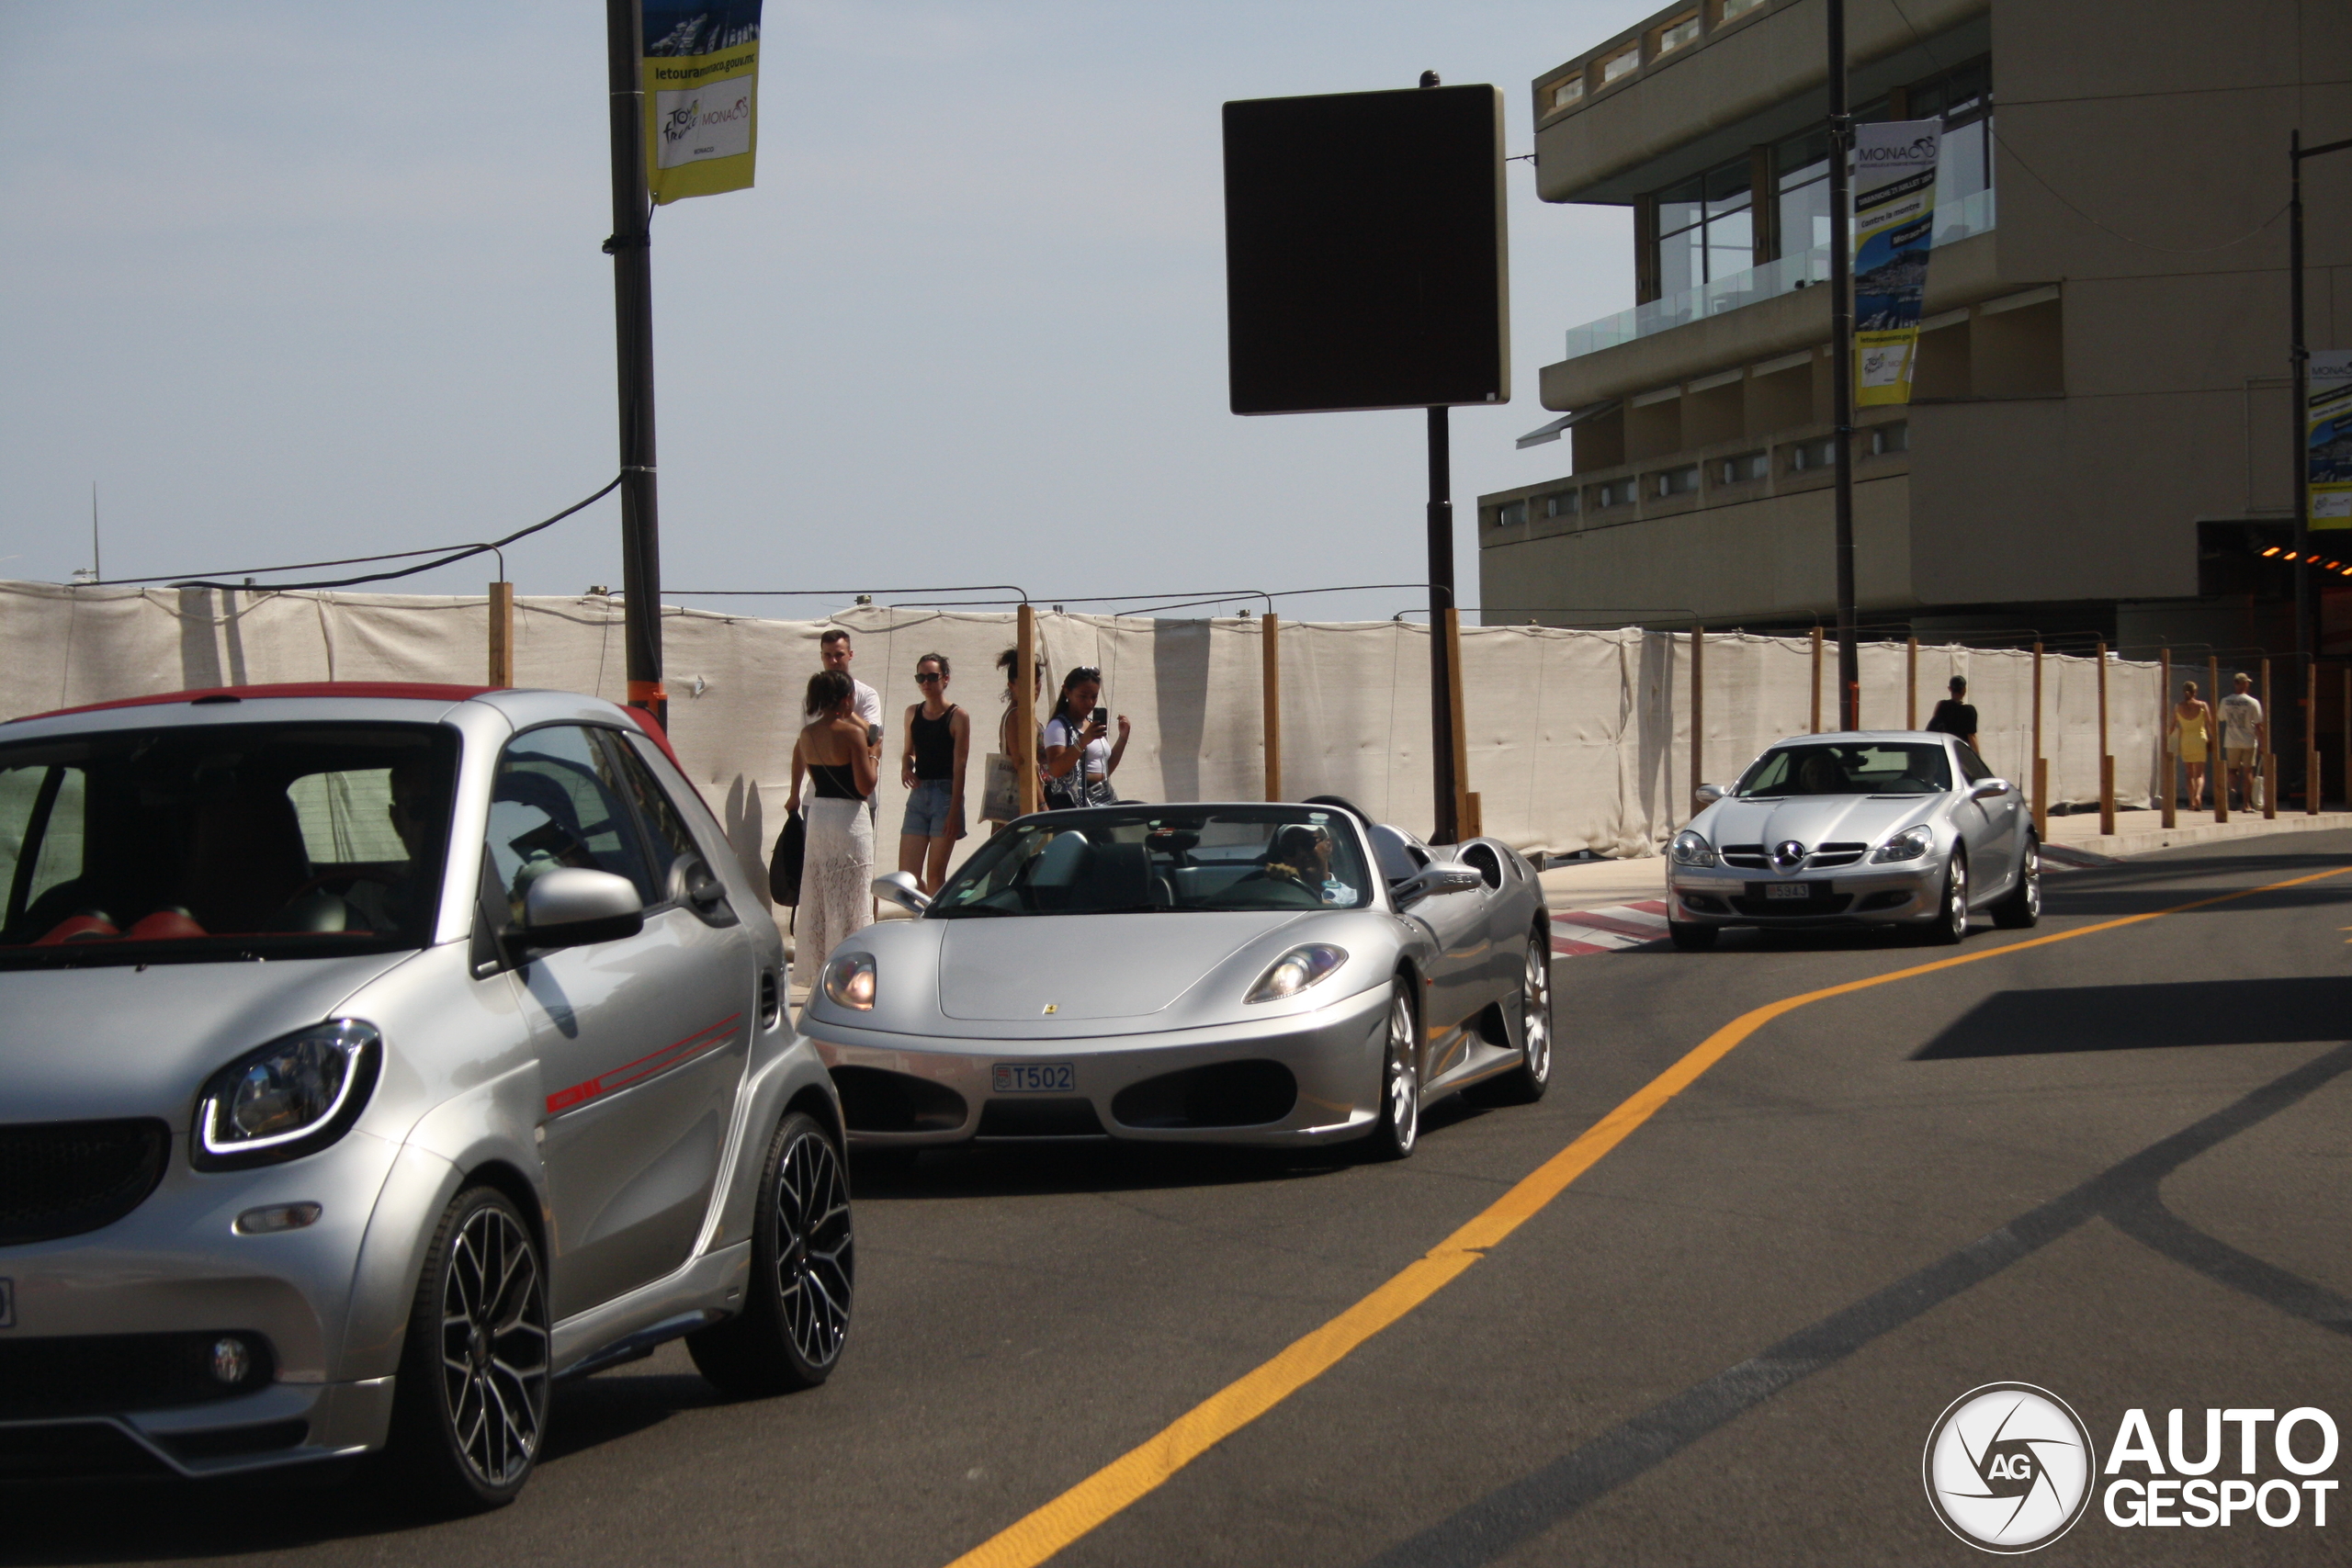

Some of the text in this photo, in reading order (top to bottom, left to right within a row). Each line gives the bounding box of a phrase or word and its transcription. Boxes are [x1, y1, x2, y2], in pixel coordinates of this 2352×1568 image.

[1859, 143, 1936, 162] MONACO
[1858, 189, 1891, 207] DIMANCHE
[1860, 215, 1885, 229] Contre
[1893, 202, 1921, 217] montre
[2312, 366, 2352, 375] MONAC
[1013, 1066, 1070, 1089] T502
